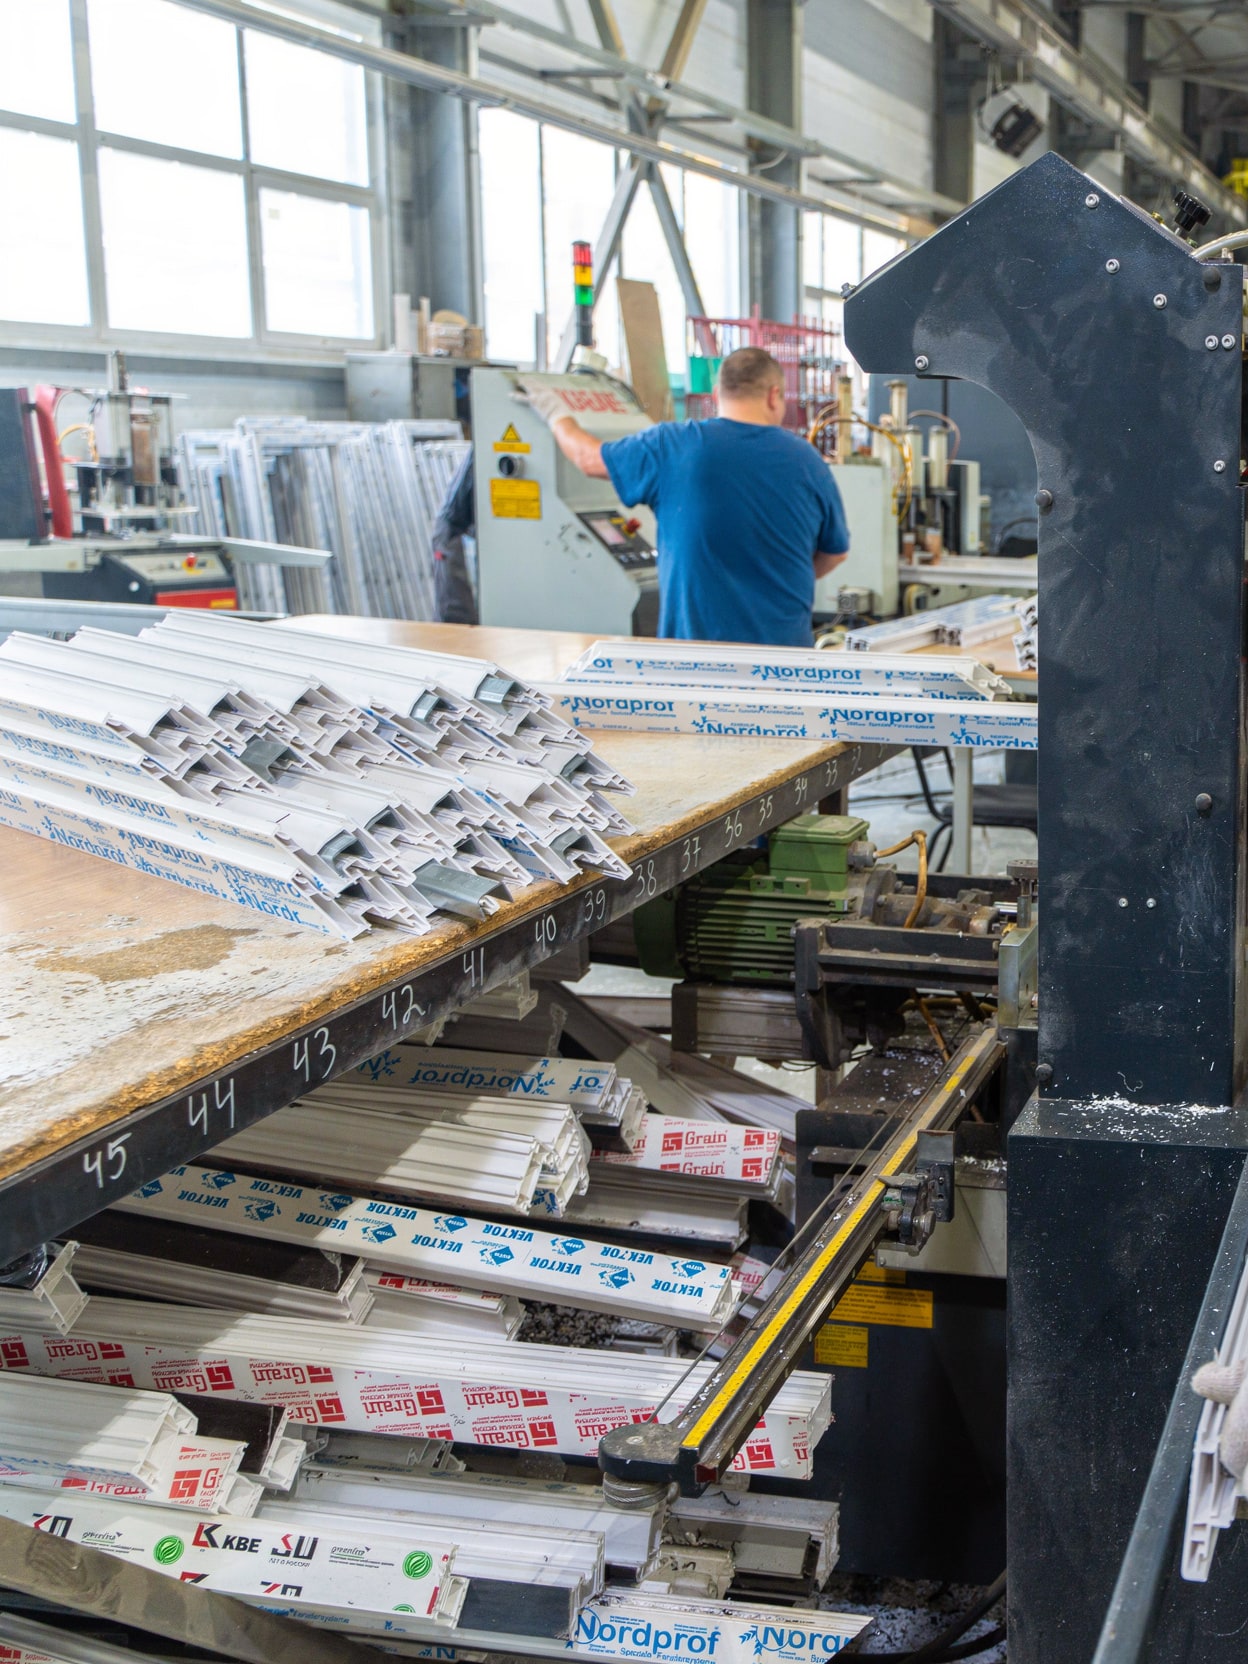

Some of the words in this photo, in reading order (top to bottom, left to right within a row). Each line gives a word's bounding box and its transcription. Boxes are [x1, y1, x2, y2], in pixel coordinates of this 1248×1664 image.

[825, 760, 837, 787] 33
[758, 795, 773, 826] 35
[724, 810, 743, 848] 36
[682, 836, 702, 873] 37
[634, 859, 657, 898] 38
[584, 889, 606, 922] 39
[534, 913, 557, 952] 40
[463, 947, 485, 988] 41
[382, 985, 426, 1030] 42
[293, 1026, 337, 1082] 43
[408, 1066, 534, 1094] Nordprof
[188, 1078, 235, 1135] 44
[684, 1130, 727, 1146] Grain
[83, 1132, 133, 1188] 45
[178, 1189, 230, 1209] VEKTOR
[366, 1201, 418, 1221] VEKTOR
[296, 1211, 349, 1231] VEKTOR
[483, 1223, 535, 1243] VEKTOR
[411, 1233, 464, 1253] VEKTOR
[529, 1256, 583, 1276] VEKTOR
[651, 1278, 705, 1298] VEKTOR
[252, 1367, 306, 1386] Grain
[363, 1399, 418, 1418] Grain
[464, 1389, 520, 1409] Grain
[221, 1534, 262, 1553] KBE
[577, 1614, 722, 1655] Nordprof
